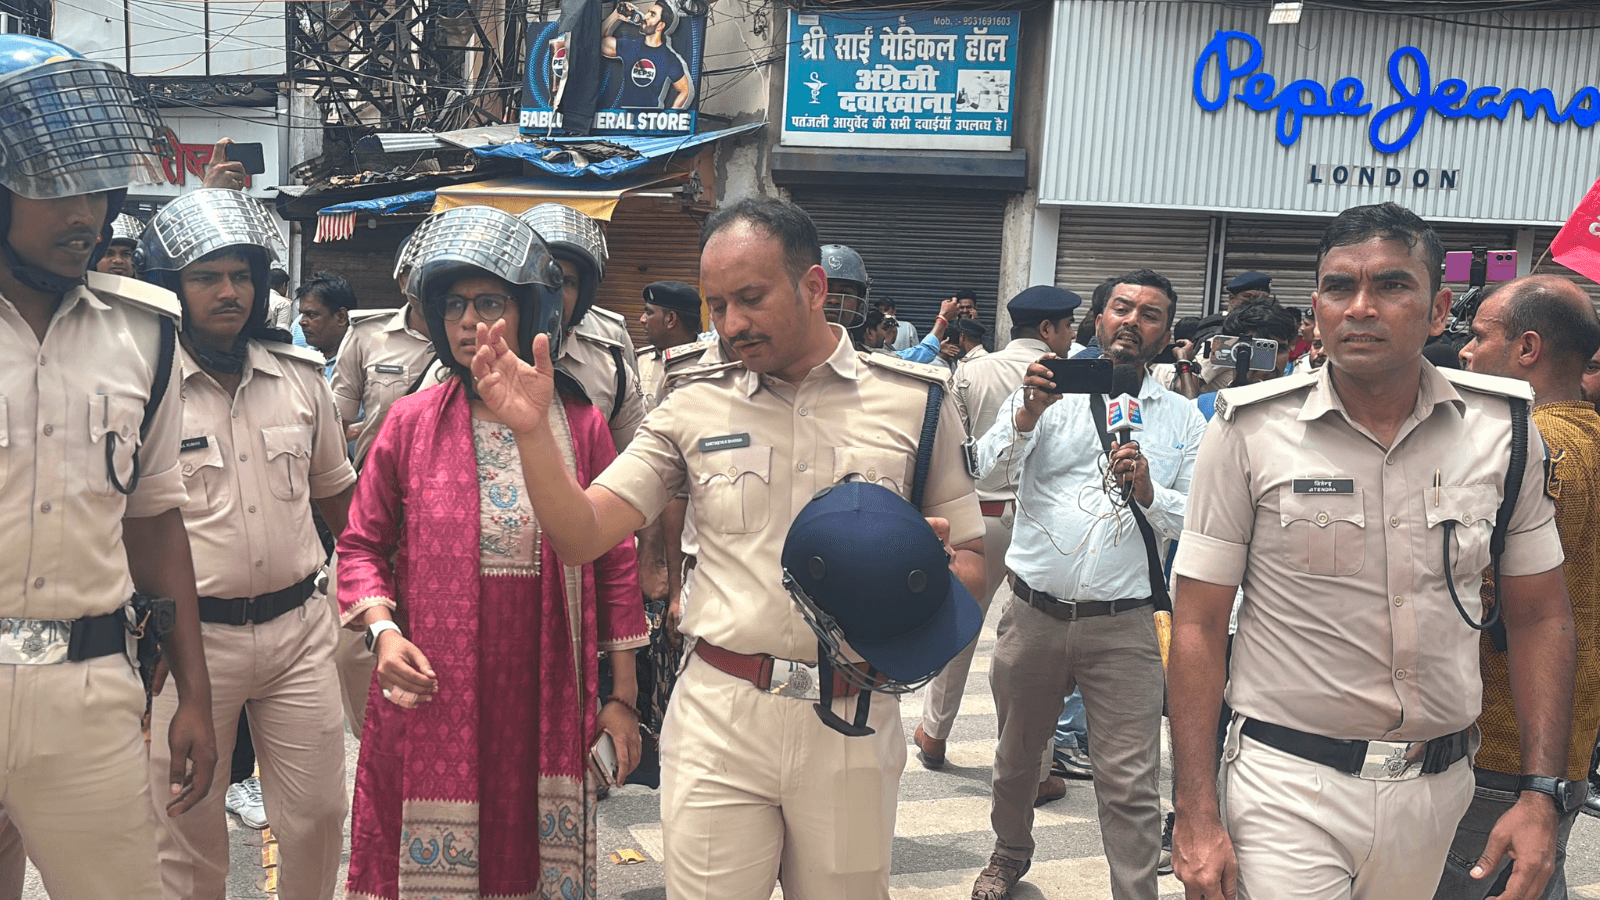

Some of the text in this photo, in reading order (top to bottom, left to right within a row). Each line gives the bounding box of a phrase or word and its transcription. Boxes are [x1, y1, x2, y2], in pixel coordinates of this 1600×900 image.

[798, 26, 827, 60] श्री
[879, 26, 958, 61] मेडिकल
[964, 27, 1009, 62] हॉल
[633, 68, 655, 78] PEPSI
[855, 64, 940, 92] अंग्रेजी
[837, 91, 956, 114] दवाखाना
[1193, 29, 1600, 154] Pepe Jeans
[594, 112, 636, 130] ERAL
[637, 112, 692, 131] STORE
[791, 113, 829, 128] पतंजली
[833, 115, 869, 132] आयुर्वेद
[872, 115, 886, 129] की
[890, 116, 911, 130] सभी
[1310, 165, 1457, 189] LONDON
